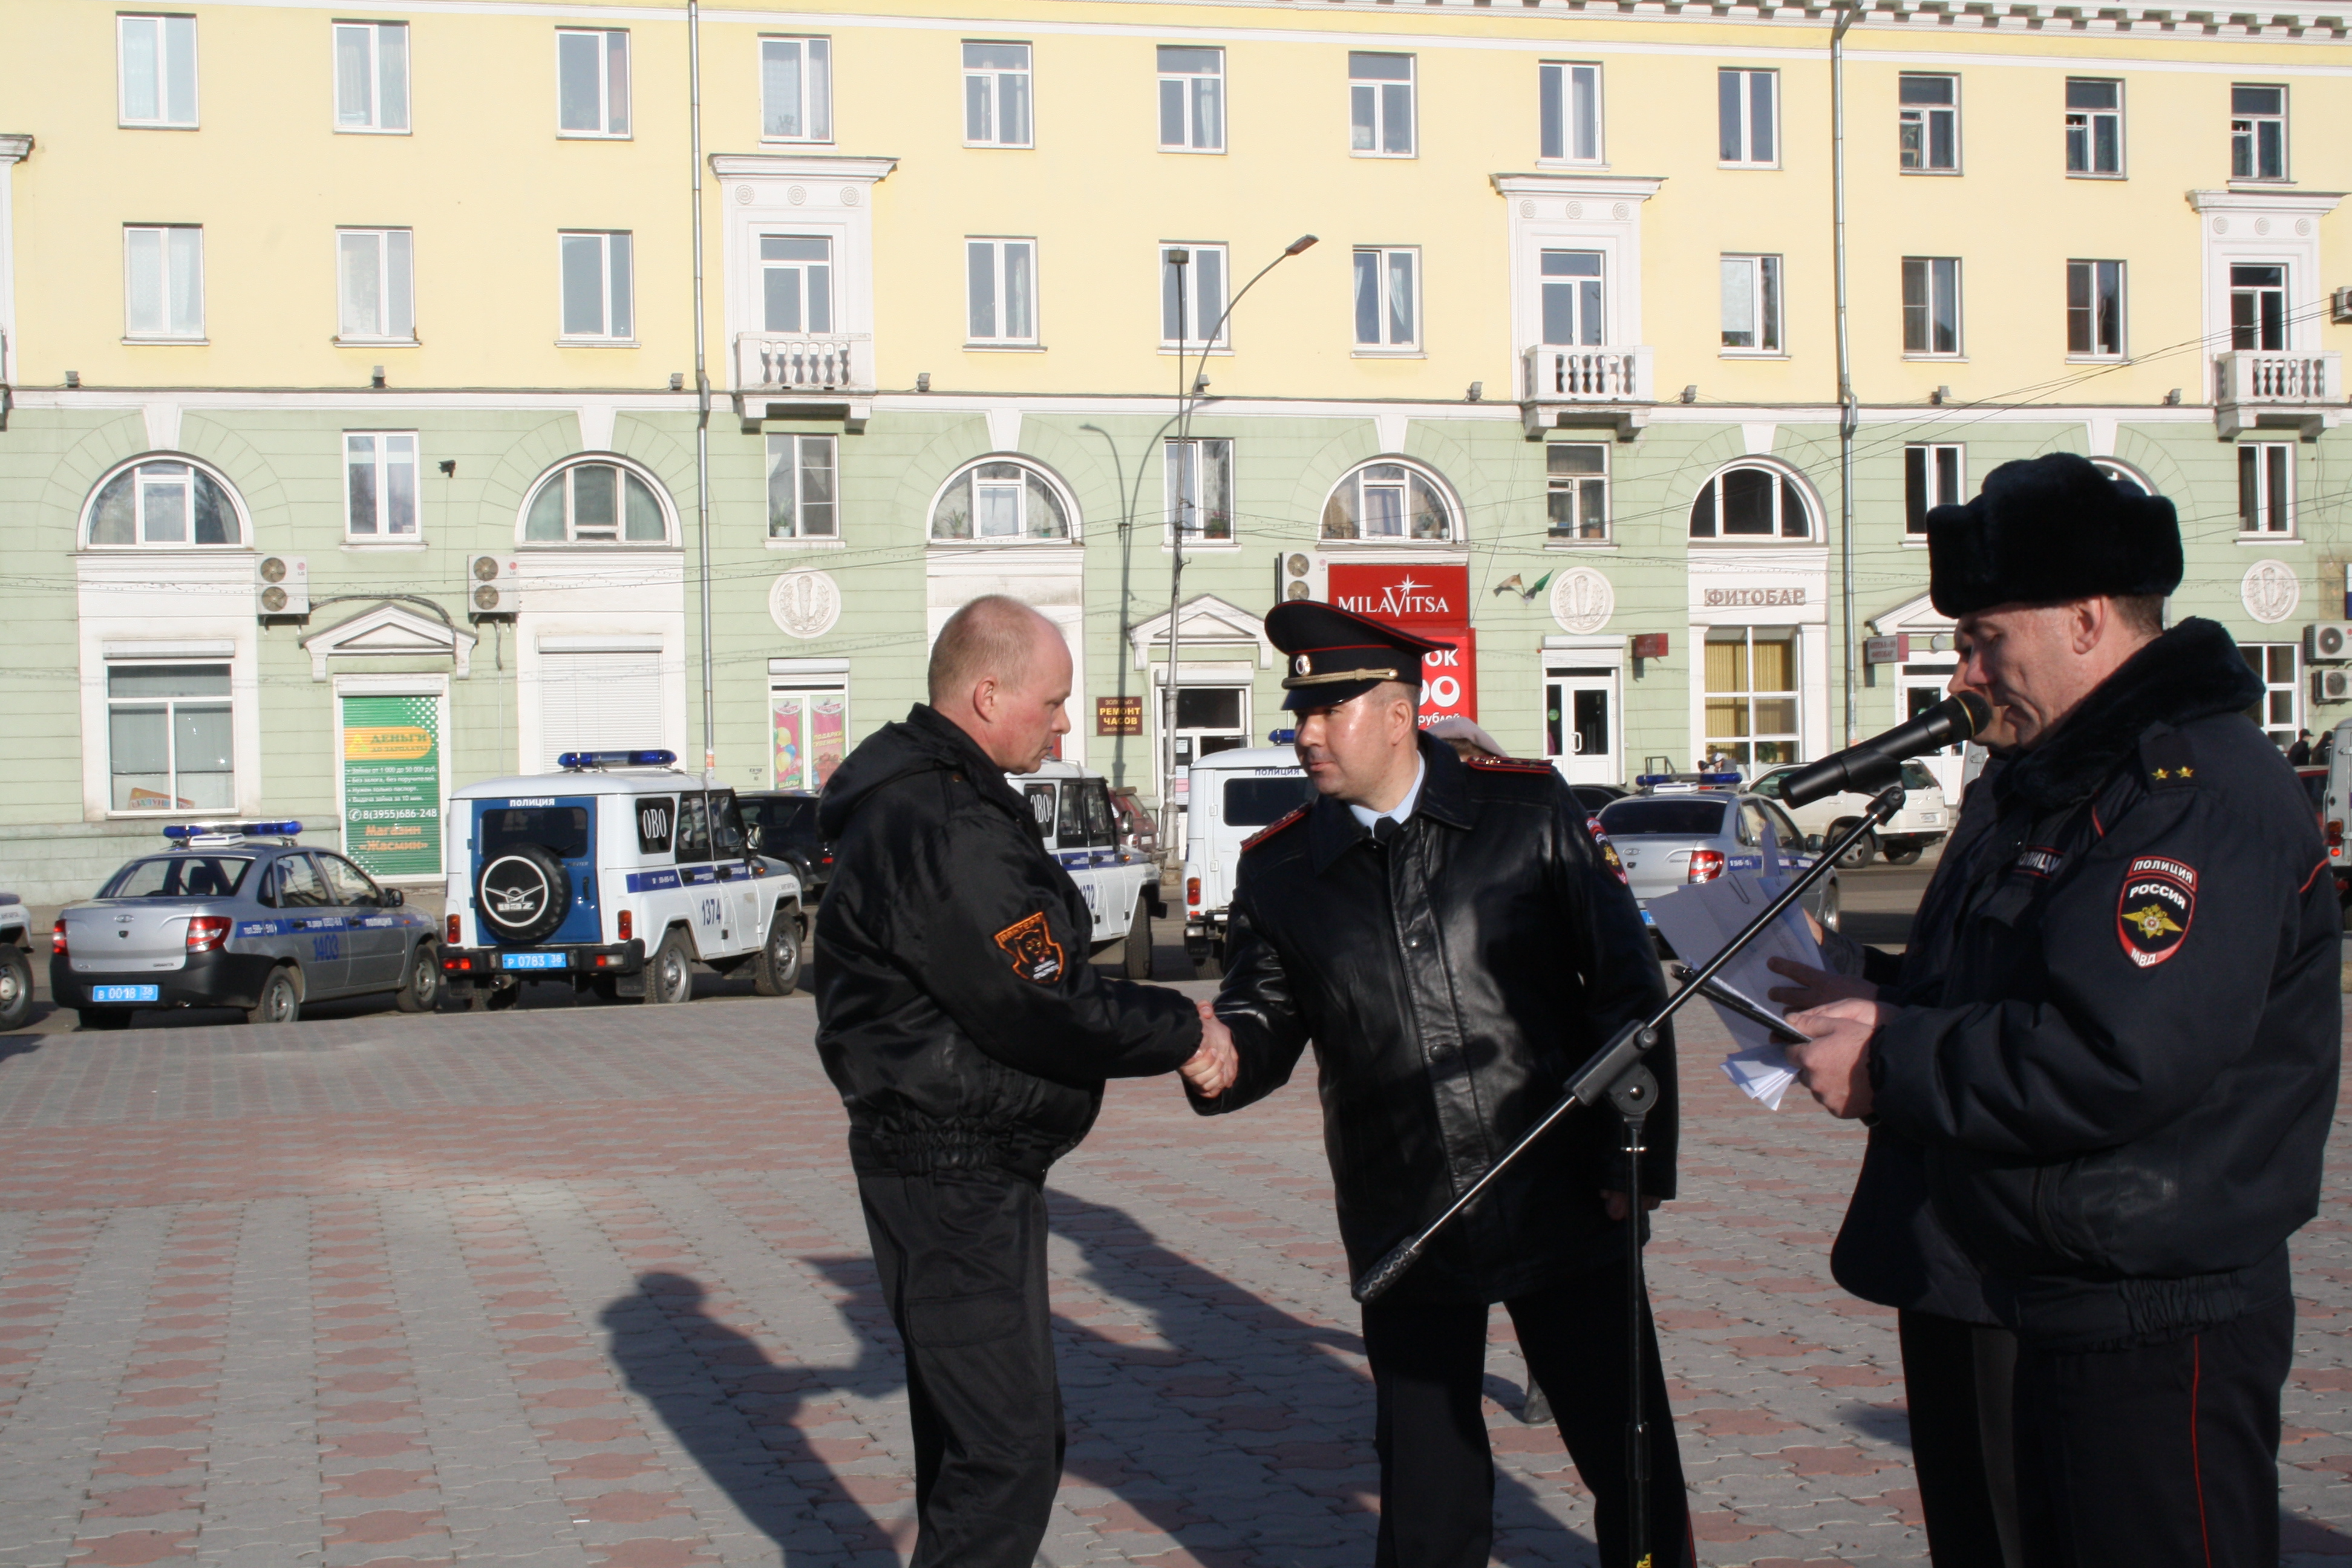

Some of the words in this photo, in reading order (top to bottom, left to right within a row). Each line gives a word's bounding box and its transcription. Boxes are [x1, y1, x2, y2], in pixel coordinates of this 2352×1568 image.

[1338, 587, 1449, 618] MILAVITSA
[1707, 589, 1805, 605] ФИТОБАР
[371, 733, 426, 743] ДЕНЬГИ
[812, 737, 845, 748] СУВЕНИРЫ
[814, 731, 843, 740] ПОДАРКИ
[509, 799, 555, 807] ПОЛИЦИЯ
[363, 808, 437, 820] 8(3955)686-248
[365, 825, 422, 836] Магазин
[643, 808, 667, 839] ОВО
[2134, 860, 2193, 883] ПОЛИЦИЯ
[2129, 884, 2186, 910] РОССИЯ
[702, 898, 721, 926] 1374
[313, 934, 339, 962] 1403
[518, 956, 544, 967] 0783
[2131, 947, 2157, 967] МВД
[109, 988, 136, 999] 0018
[142, 987, 153, 995] 38
